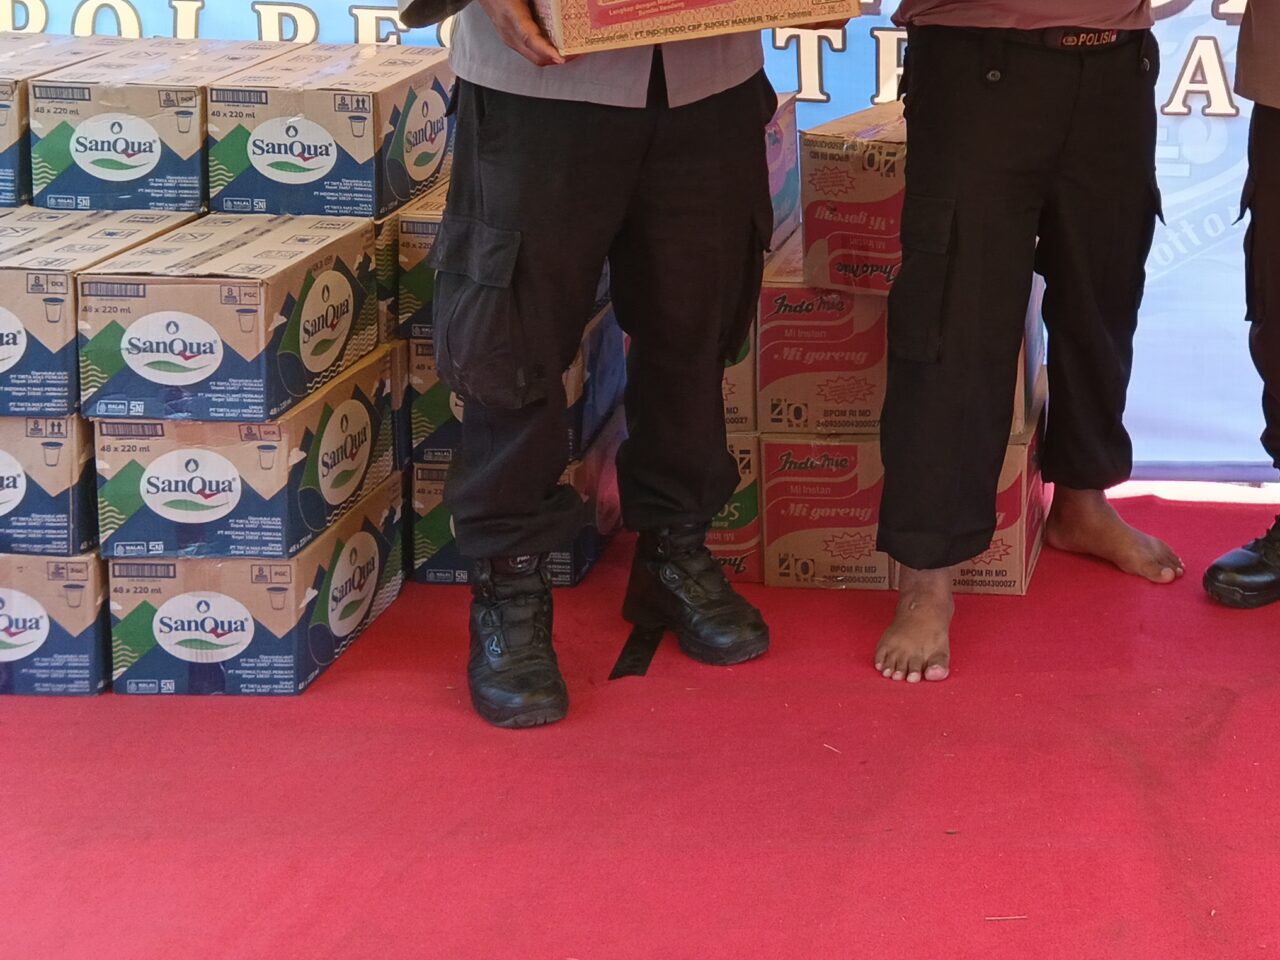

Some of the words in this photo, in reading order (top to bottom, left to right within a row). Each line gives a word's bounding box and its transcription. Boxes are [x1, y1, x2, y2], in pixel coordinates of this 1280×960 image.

[1077, 30, 1117, 47] POLISI
[34, 106, 45, 114] 48
[53, 107, 68, 115] 220
[229, 110, 244, 119] 220
[75, 135, 154, 156] SanQua
[252, 138, 331, 159] SanQua
[253, 198, 267, 212] SNI
[81, 305, 94, 314] 48
[101, 305, 117, 314] 220
[303, 297, 350, 338] SanQua
[127, 336, 217, 356] SanQua
[129, 401, 145, 416] SNI
[100, 444, 112, 453] 48
[121, 444, 137, 453] 220
[321, 423, 367, 477] SanQua
[146, 474, 235, 495] SanQua
[112, 586, 125, 595] 48
[133, 586, 149, 595] 220
[331, 558, 376, 613] SanQua
[159, 615, 247, 635] SanQua
[160, 680, 175, 694] SNI
